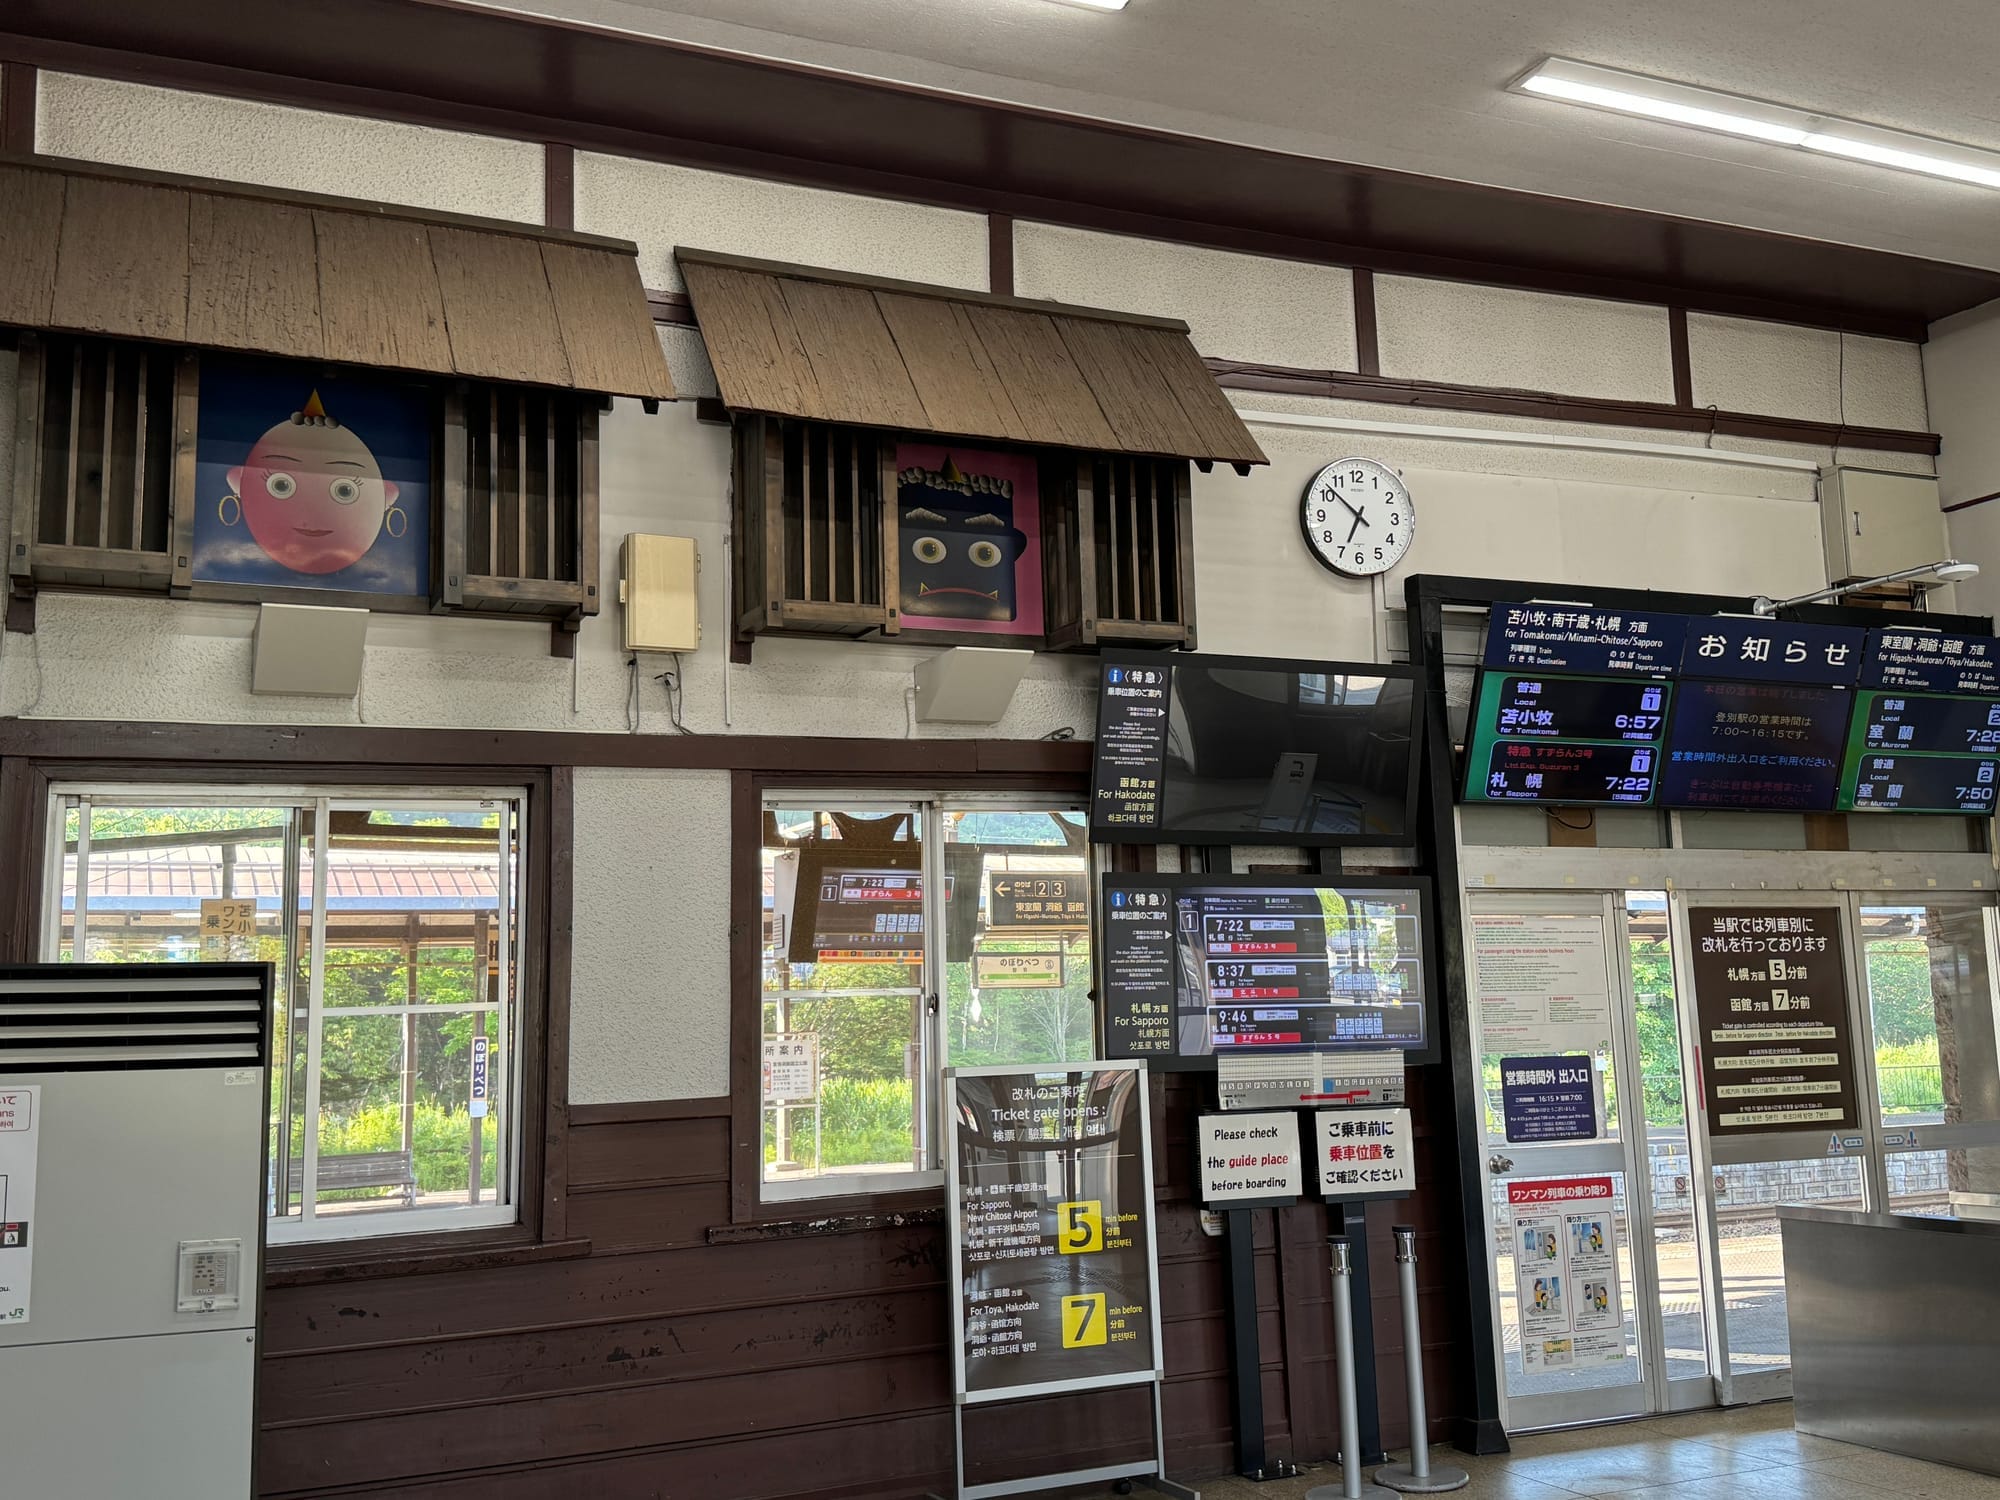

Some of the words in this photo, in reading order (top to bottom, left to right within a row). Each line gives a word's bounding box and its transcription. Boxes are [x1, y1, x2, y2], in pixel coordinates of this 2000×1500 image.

[1332, 475, 1344, 488] 11
[1350, 471, 1363, 483] 12
[1372, 477, 1377, 489] 1
[1320, 489, 1335, 502] 10
[1386, 492, 1394, 504] 2
[1317, 510, 1325, 522] 9
[1391, 513, 1399, 525] 3
[1324, 531, 1332, 543] 8
[1386, 533, 1394, 545] 4
[1337, 546, 1345, 558] 7
[1355, 552, 1364, 564] 6
[1374, 548, 1382, 559] 5
[1507, 610, 1621, 631] 苫小牧・南千歳・札幌
[1628, 621, 1648, 633] 方面
[1505, 629, 1516, 638] for
[1520, 629, 1663, 649] Tomakomai/Minami-Chitose/Sapporo
[1881, 635, 1964, 654] 東室蘭・洞爺・函館
[1969, 645, 1985, 655] 方面
[1698, 634, 1849, 666] お知らせ
[1878, 652, 1888, 661] for
[1537, 657, 1566, 665] Destination
[1107, 687, 1162, 698] 乗車位置のご案内
[1517, 682, 1541, 694] 普通
[1884, 700, 1904, 710] 普通
[1501, 708, 1554, 726] 苫小牧
[1615, 715, 1661, 729] 6:57
[1715, 712, 1812, 727] 登別駅の営業時間は
[1868, 724, 1914, 740] 室蘭
[1966, 729, 2000, 743] 7:28
[1507, 745, 1531, 757] 特急
[1873, 759, 1894, 769] 普通
[1491, 772, 1543, 789] 札幌
[1605, 777, 1650, 791] 7:22
[1098, 789, 1112, 798] For
[1115, 790, 1155, 800] Hakodate
[1857, 783, 1904, 799] 室蘭
[1955, 787, 1993, 800] 7:50
[862, 879, 883, 887] 7:22
[1038, 883, 1046, 895] 2
[1054, 883, 1062, 895] 3
[1016, 903, 1042, 912] 東室蘭
[1111, 911, 1167, 920] 乗車位置のご案内
[1216, 920, 1244, 931] 7:22
[1714, 917, 1814, 933] 当駅では列車別に
[1702, 936, 1828, 953] 改札を行っております
[1000, 958, 1039, 966] のぼりべつ
[1217, 965, 1245, 977] 8:37
[1728, 967, 1766, 981] 札幌方面
[1774, 963, 1782, 978] 5
[1787, 966, 1807, 979] 分前
[1730, 998, 1769, 1012] 函館方面
[1776, 993, 1785, 1008] 7
[1790, 996, 1810, 1009] 分前
[1115, 1017, 1129, 1026] For
[1132, 1016, 1169, 1028] Sapporo
[1219, 1011, 1247, 1022] 9:46
[1155, 1040, 1170, 1050] 방면
[475, 1041, 486, 1096] のぼりべつ
[1506, 1070, 1556, 1086] 営業時間外
[1559, 1069, 1588, 1083] 出入口
[1012, 1086, 1085, 1101] 改札のご案内
[992, 1108, 1030, 1121] Ticket
[1033, 1108, 1059, 1122] gate
[1064, 1106, 1099, 1120] opens
[1214, 1129, 1245, 1141] Please
[1250, 1126, 1278, 1138] check
[1328, 1121, 1394, 1138] ご乗車前に
[1329, 1144, 1395, 1162] 乗車位置を
[1208, 1156, 1225, 1169] the
[1229, 1154, 1257, 1169] guide
[1261, 1154, 1288, 1170] place
[1326, 1168, 1403, 1185] ご確認ください
[1212, 1179, 1243, 1191] before
[1246, 1177, 1286, 1189] boarding
[1512, 1185, 1607, 1200] ワンマン列車の乗り降り
[967, 1202, 978, 1210] For
[980, 1201, 1011, 1211] Sapporo,
[967, 1214, 983, 1223] New
[985, 1212, 1011, 1221] Chitose
[1013, 1210, 1038, 1221] Airport
[1118, 1213, 1138, 1222] before
[1069, 1207, 1092, 1247] 5
[970, 1308, 982, 1316] For
[984, 1305, 1004, 1315] Toya,
[1005, 1302, 1040, 1312] Hakodate
[1122, 1305, 1143, 1314] before
[1071, 1299, 1096, 1341] 7
